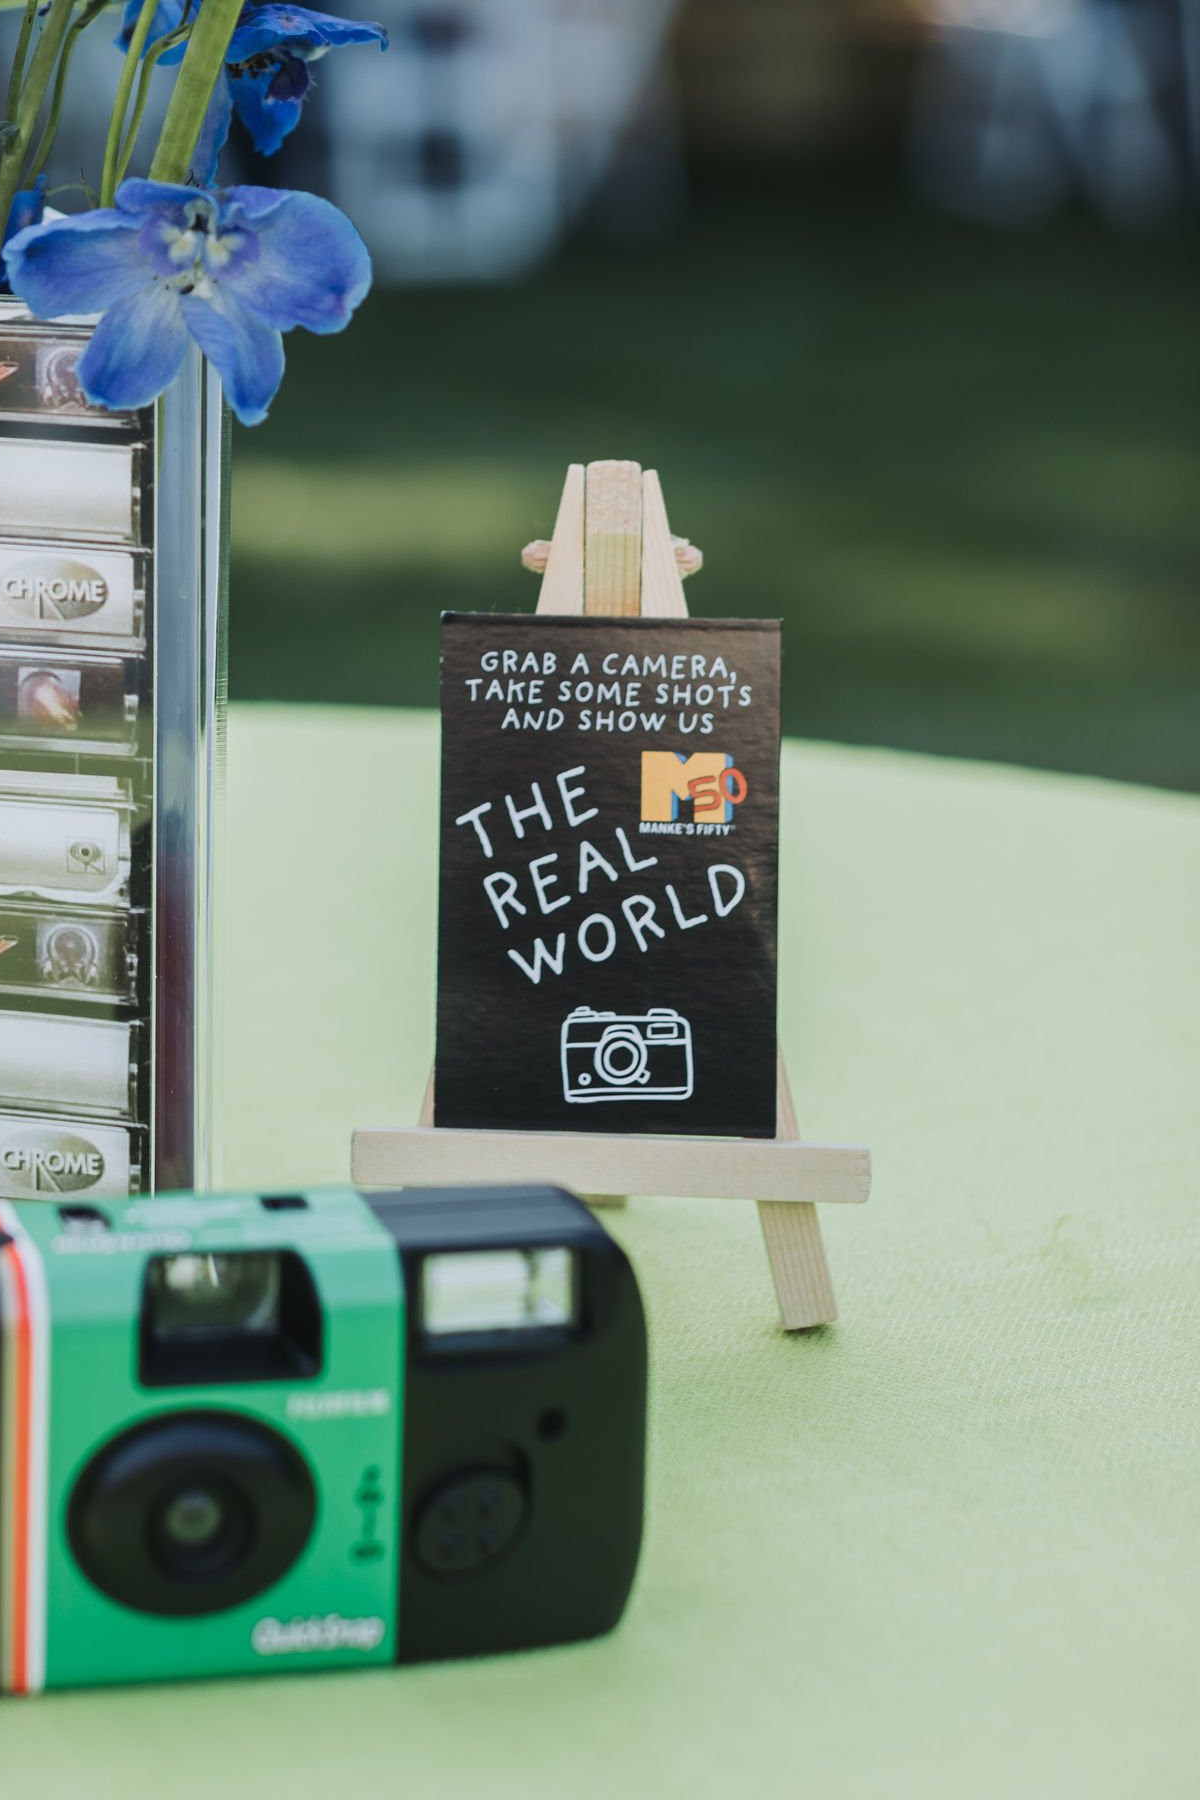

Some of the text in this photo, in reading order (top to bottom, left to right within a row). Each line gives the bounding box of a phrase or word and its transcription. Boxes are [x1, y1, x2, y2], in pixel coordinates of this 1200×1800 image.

[3, 575, 106, 621] CHROME
[481, 650, 738, 684] GRAB A CAMERA,
[465, 678, 753, 709] TAKE SOME SHOTS
[501, 708, 715, 735] AND SHOW US
[455, 765, 599, 857] THE
[639, 822, 731, 836] MANKE'S FIFTY
[483, 827, 658, 929] REAL
[508, 863, 746, 984] WORLD
[0, 1147, 101, 1192] CHROME
